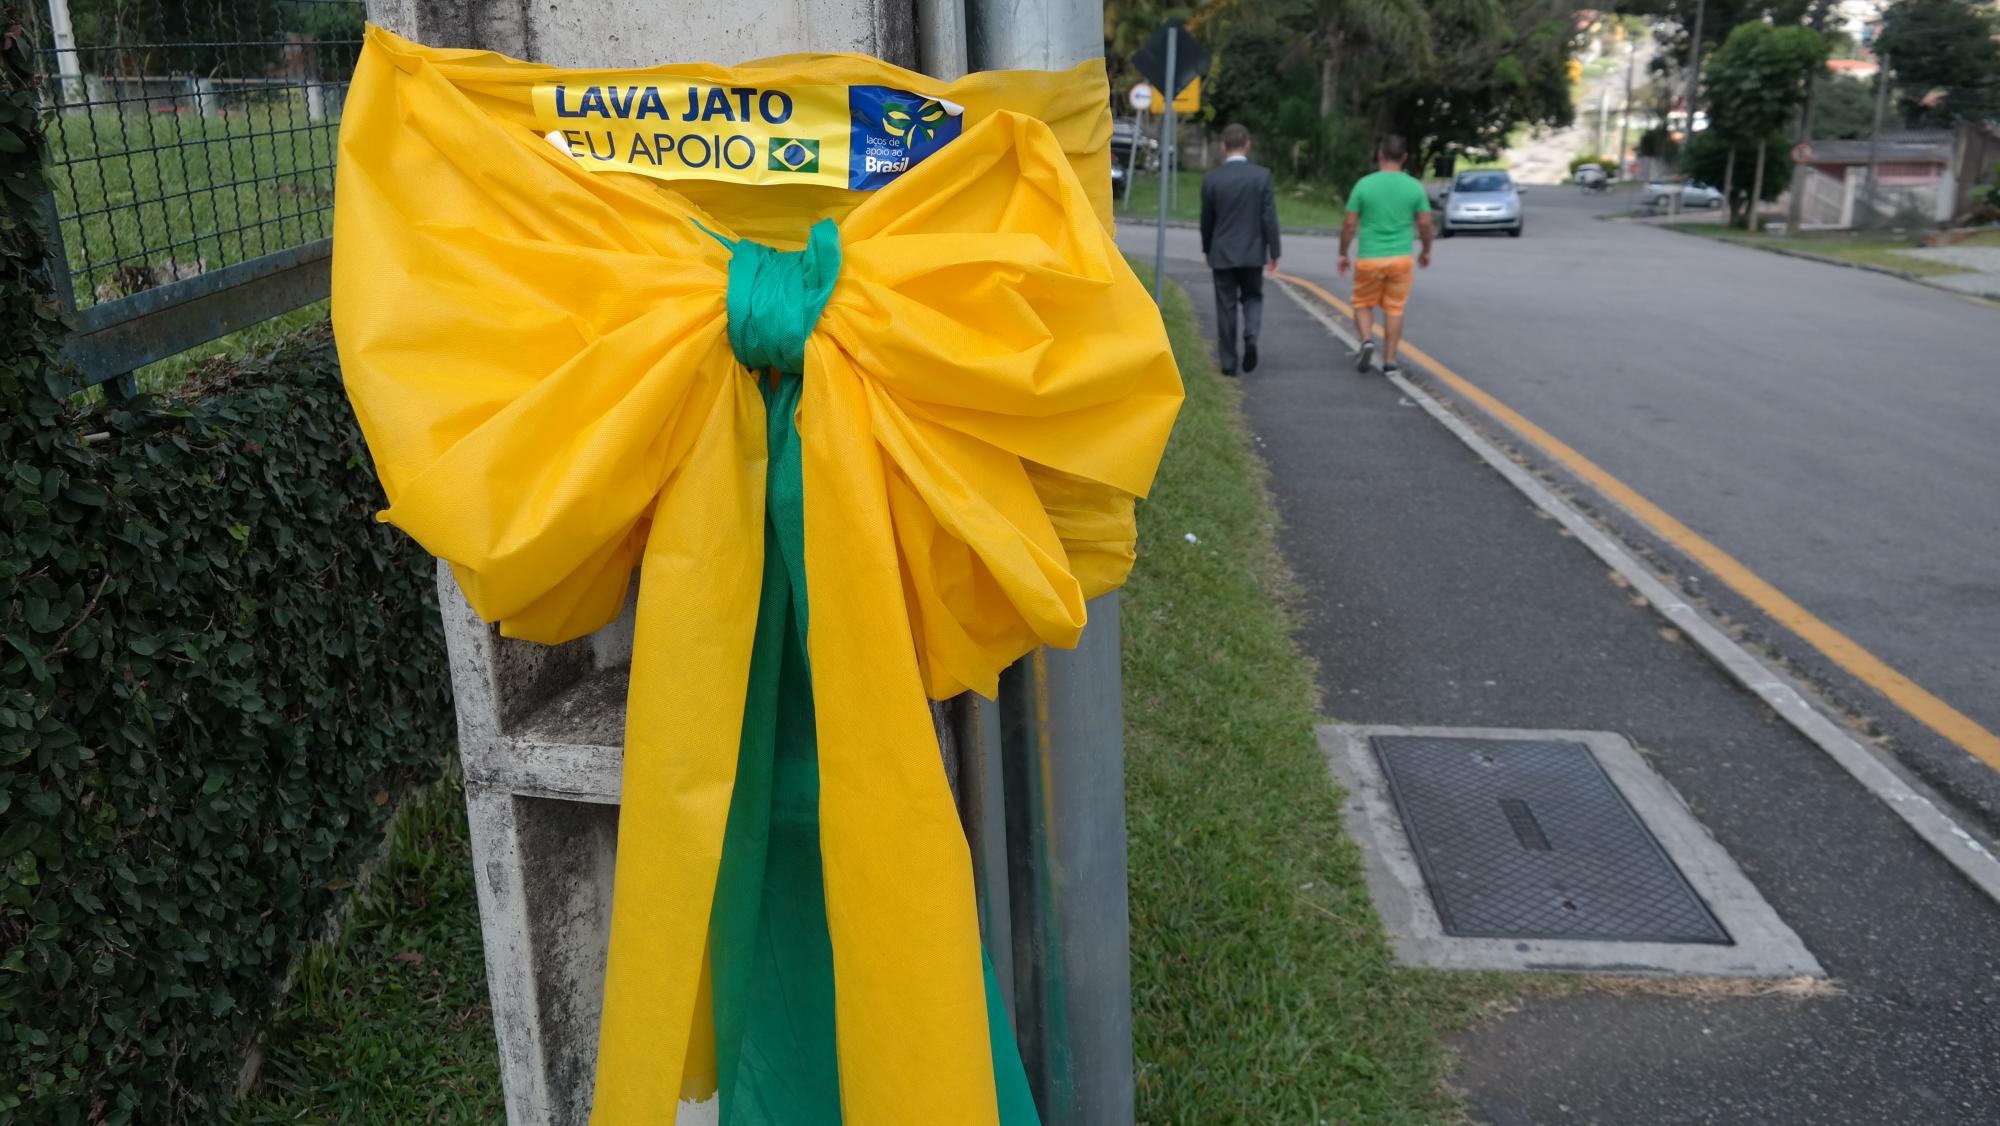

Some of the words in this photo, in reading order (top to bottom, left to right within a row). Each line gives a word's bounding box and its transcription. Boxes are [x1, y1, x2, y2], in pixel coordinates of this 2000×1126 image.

[555, 85, 670, 121] LAVA
[682, 87, 793, 125] JATO
[866, 134, 887, 146] laços
[889, 136, 900, 147] de
[562, 129, 616, 161] EU
[627, 132, 756, 170] APOIO
[865, 147, 890, 157] apoio
[891, 148, 903, 157] ao
[865, 156, 910, 173] Brasil
